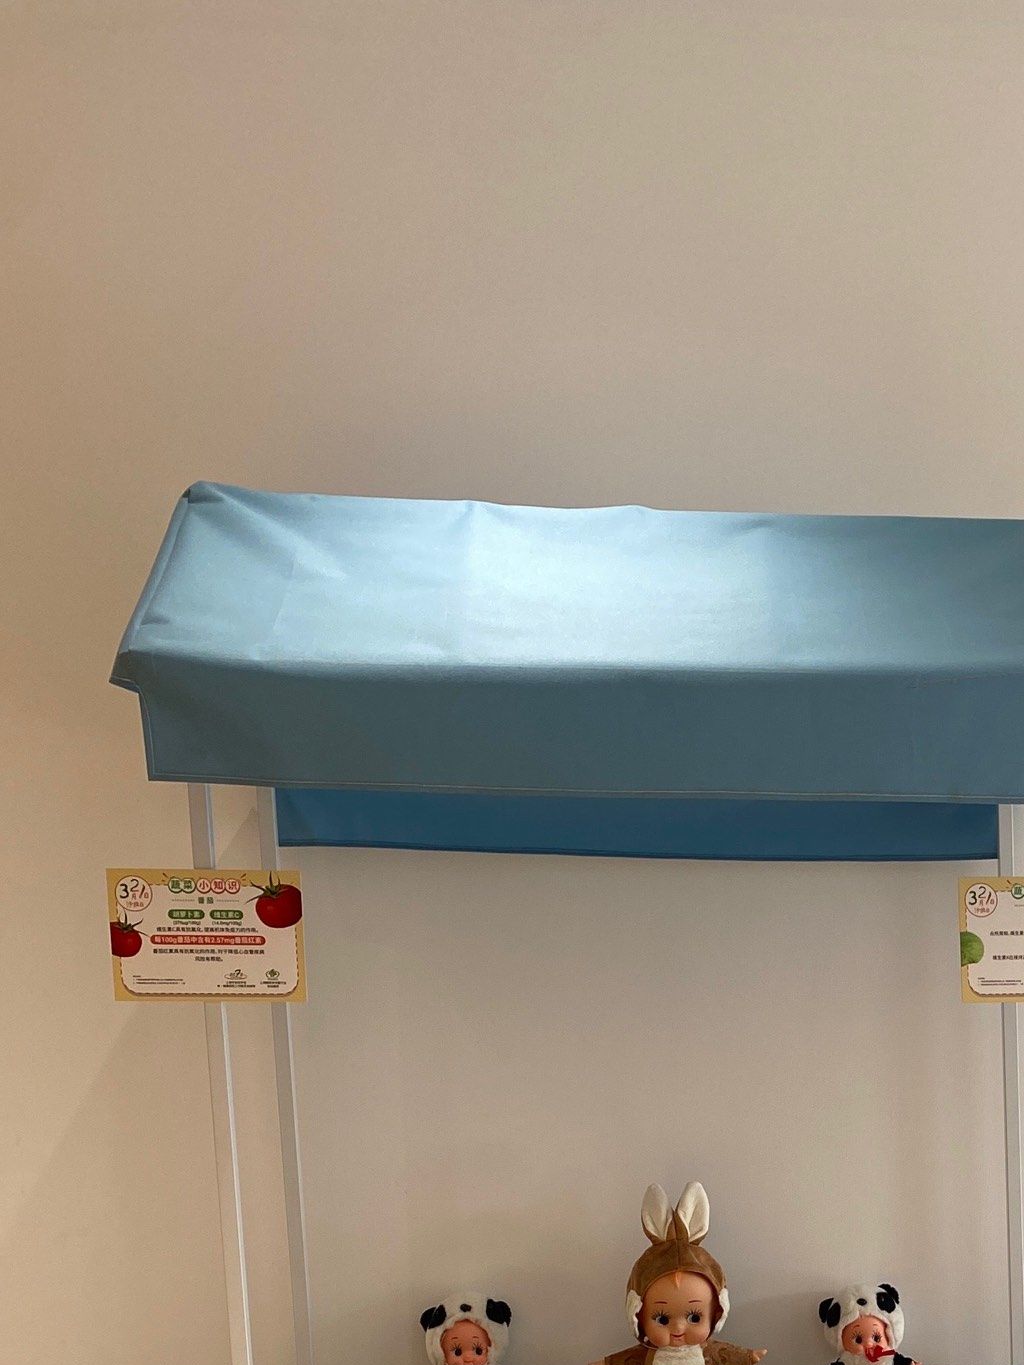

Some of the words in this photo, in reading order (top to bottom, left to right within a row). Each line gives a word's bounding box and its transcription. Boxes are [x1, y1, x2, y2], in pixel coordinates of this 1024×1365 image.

[170, 879, 238, 891] 蔬菜小知识
